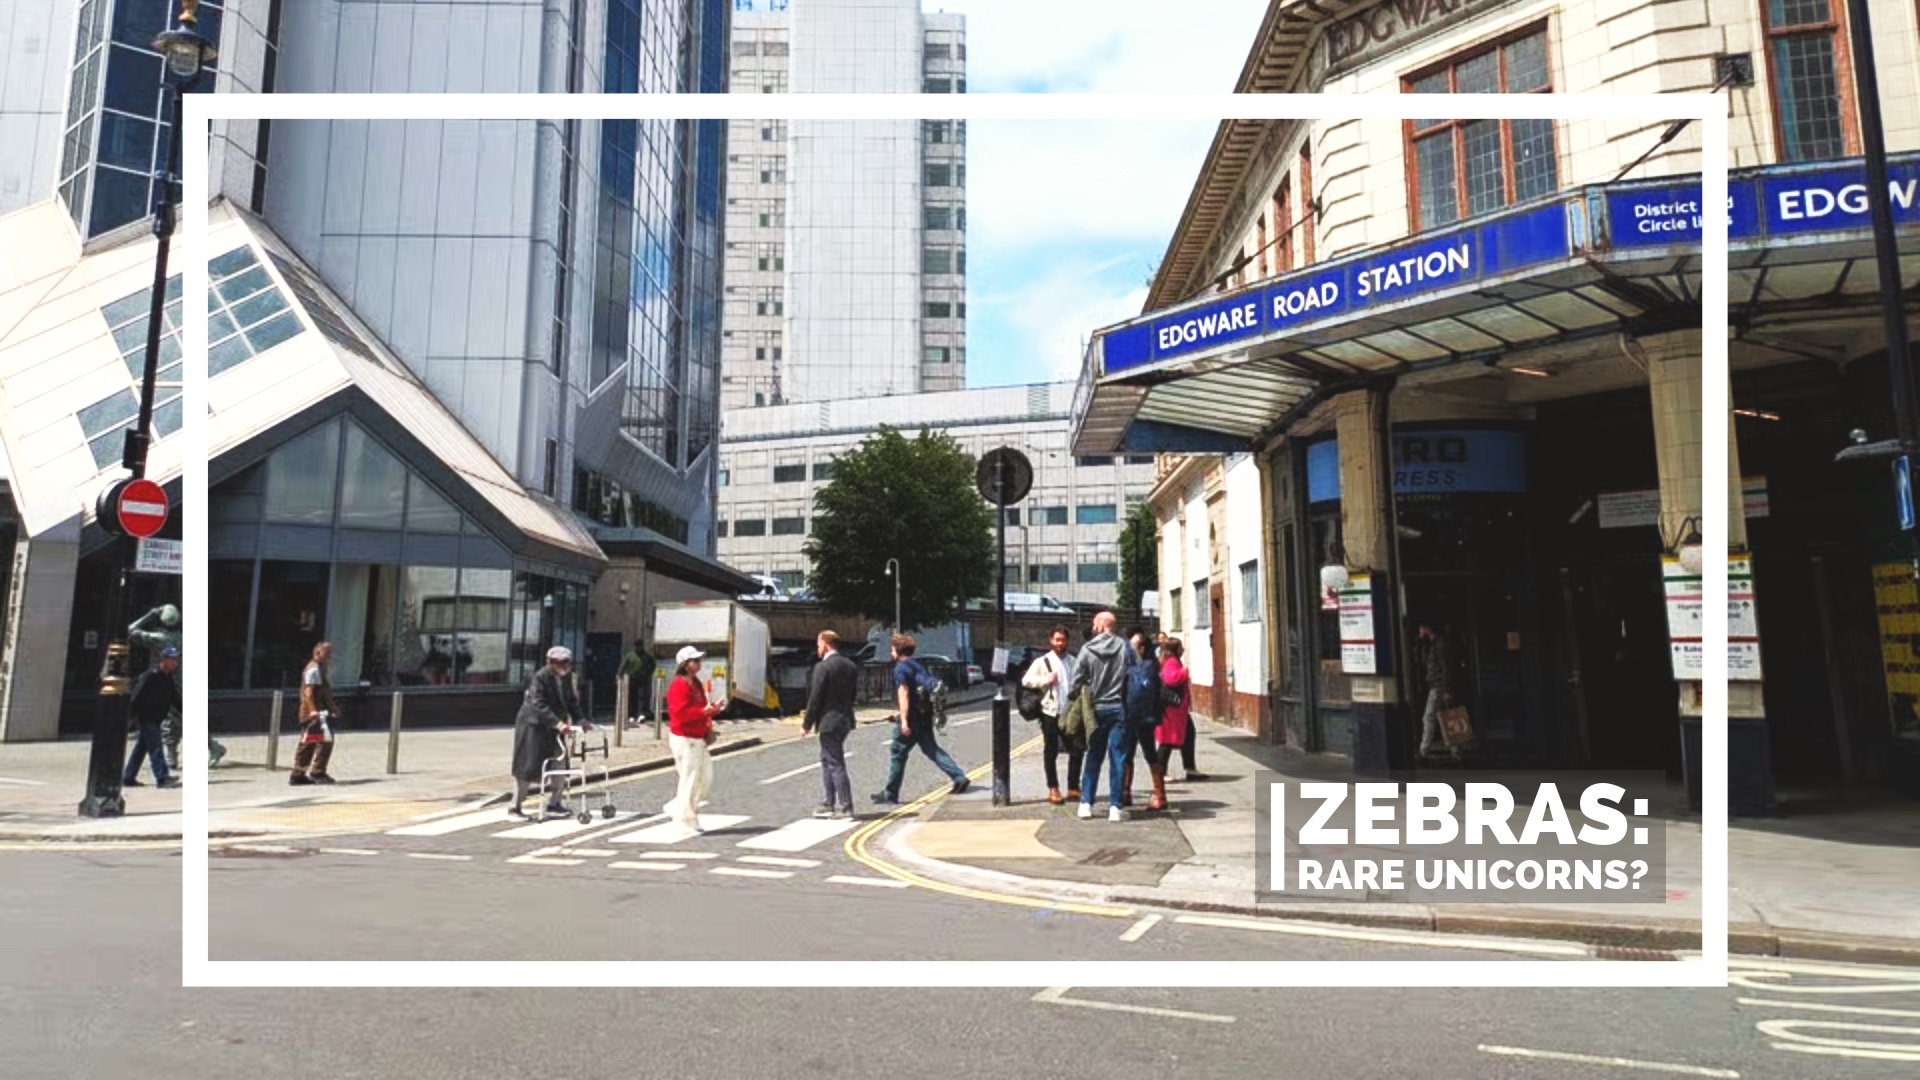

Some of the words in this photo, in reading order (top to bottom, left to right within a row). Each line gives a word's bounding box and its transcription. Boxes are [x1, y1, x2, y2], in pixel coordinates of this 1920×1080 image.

[1635, 201, 1698, 218] District
[1779, 179, 1920, 220] EDGW
[1638, 218, 1688, 233] Circle
[1158, 303, 1258, 350] EDGWARE
[1273, 281, 1339, 319] ROAD
[1357, 244, 1469, 297] STATION
